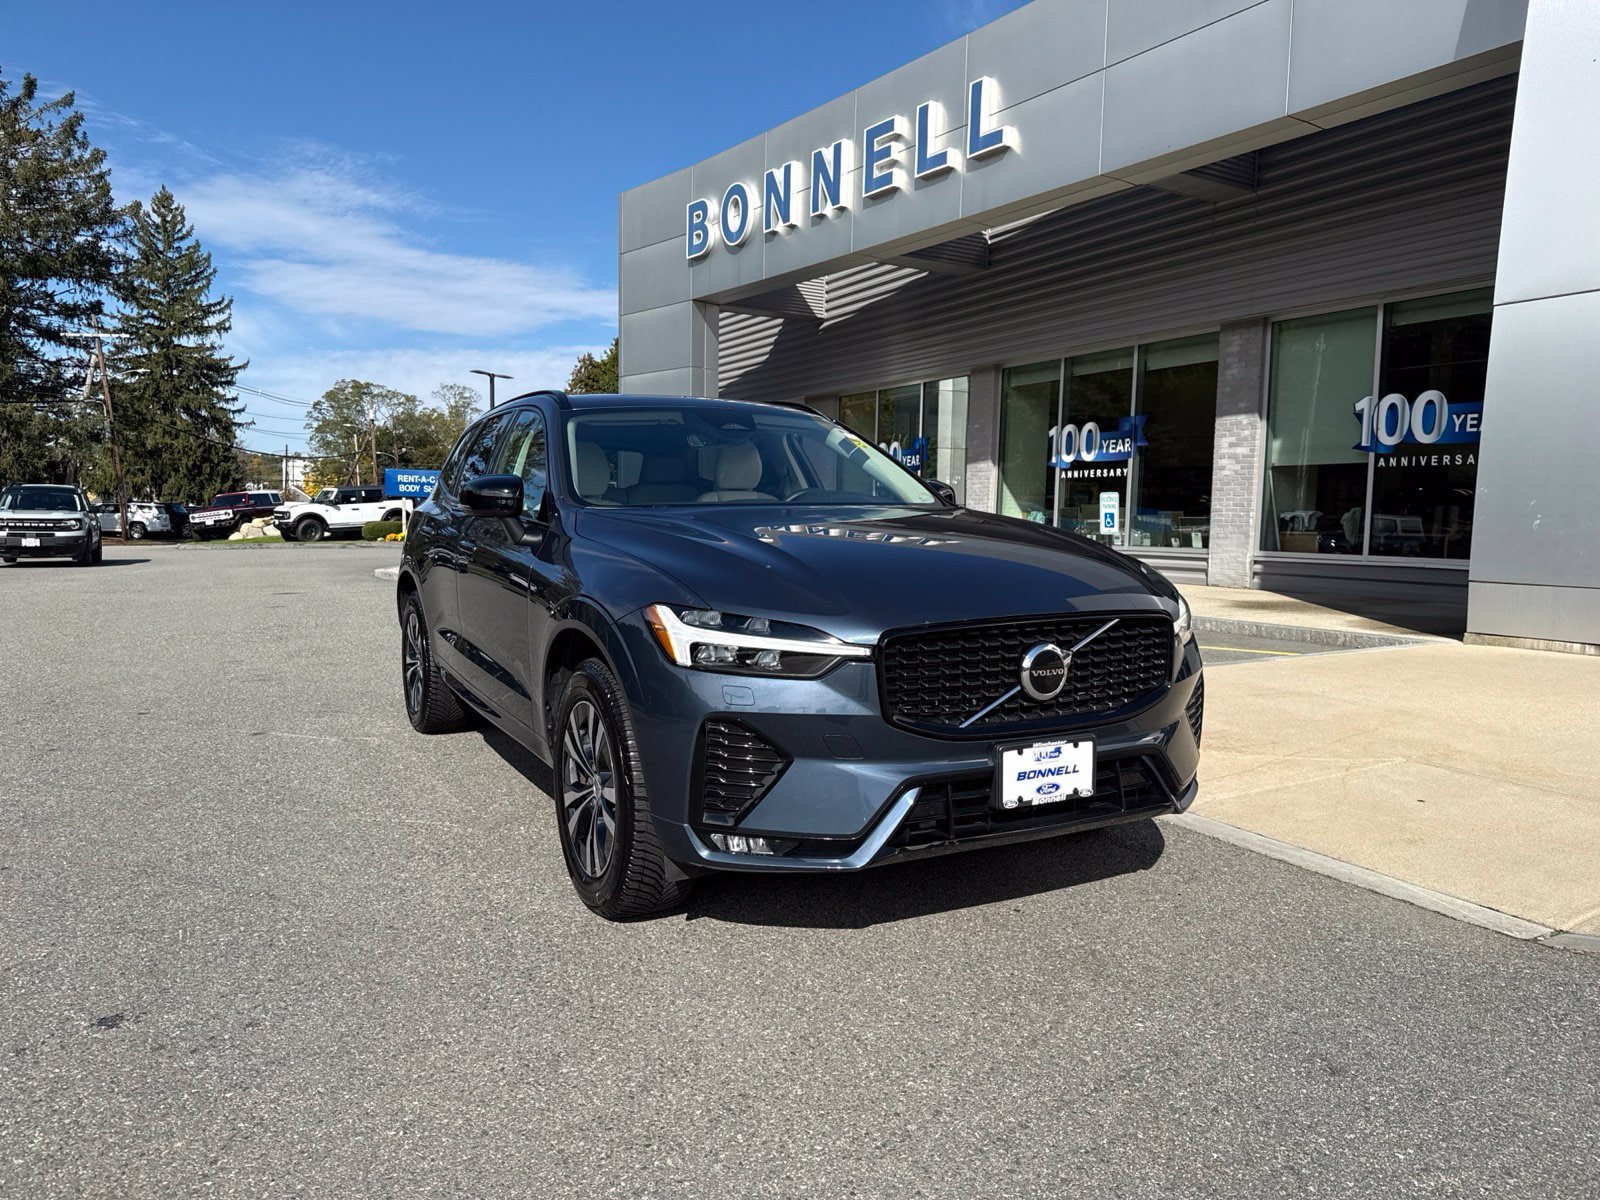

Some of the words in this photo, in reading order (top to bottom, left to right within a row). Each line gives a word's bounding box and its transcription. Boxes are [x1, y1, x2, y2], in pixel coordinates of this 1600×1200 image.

[686, 76, 1013, 260] BONNELL
[1355, 390, 1449, 446] 100
[1048, 421, 1100, 463] 100
[1102, 438, 1131, 453] YEAR
[1378, 454, 1475, 467] ANNIVERSA
[397, 474, 436, 483] RENT-A-C
[1061, 467, 1129, 478] ANNIVERSARY
[399, 483, 420, 492] BODY
[1031, 668, 1064, 676] VOLVO
[1016, 764, 1080, 781] BONNELL
[1031, 793, 1066, 806] Bonnell
